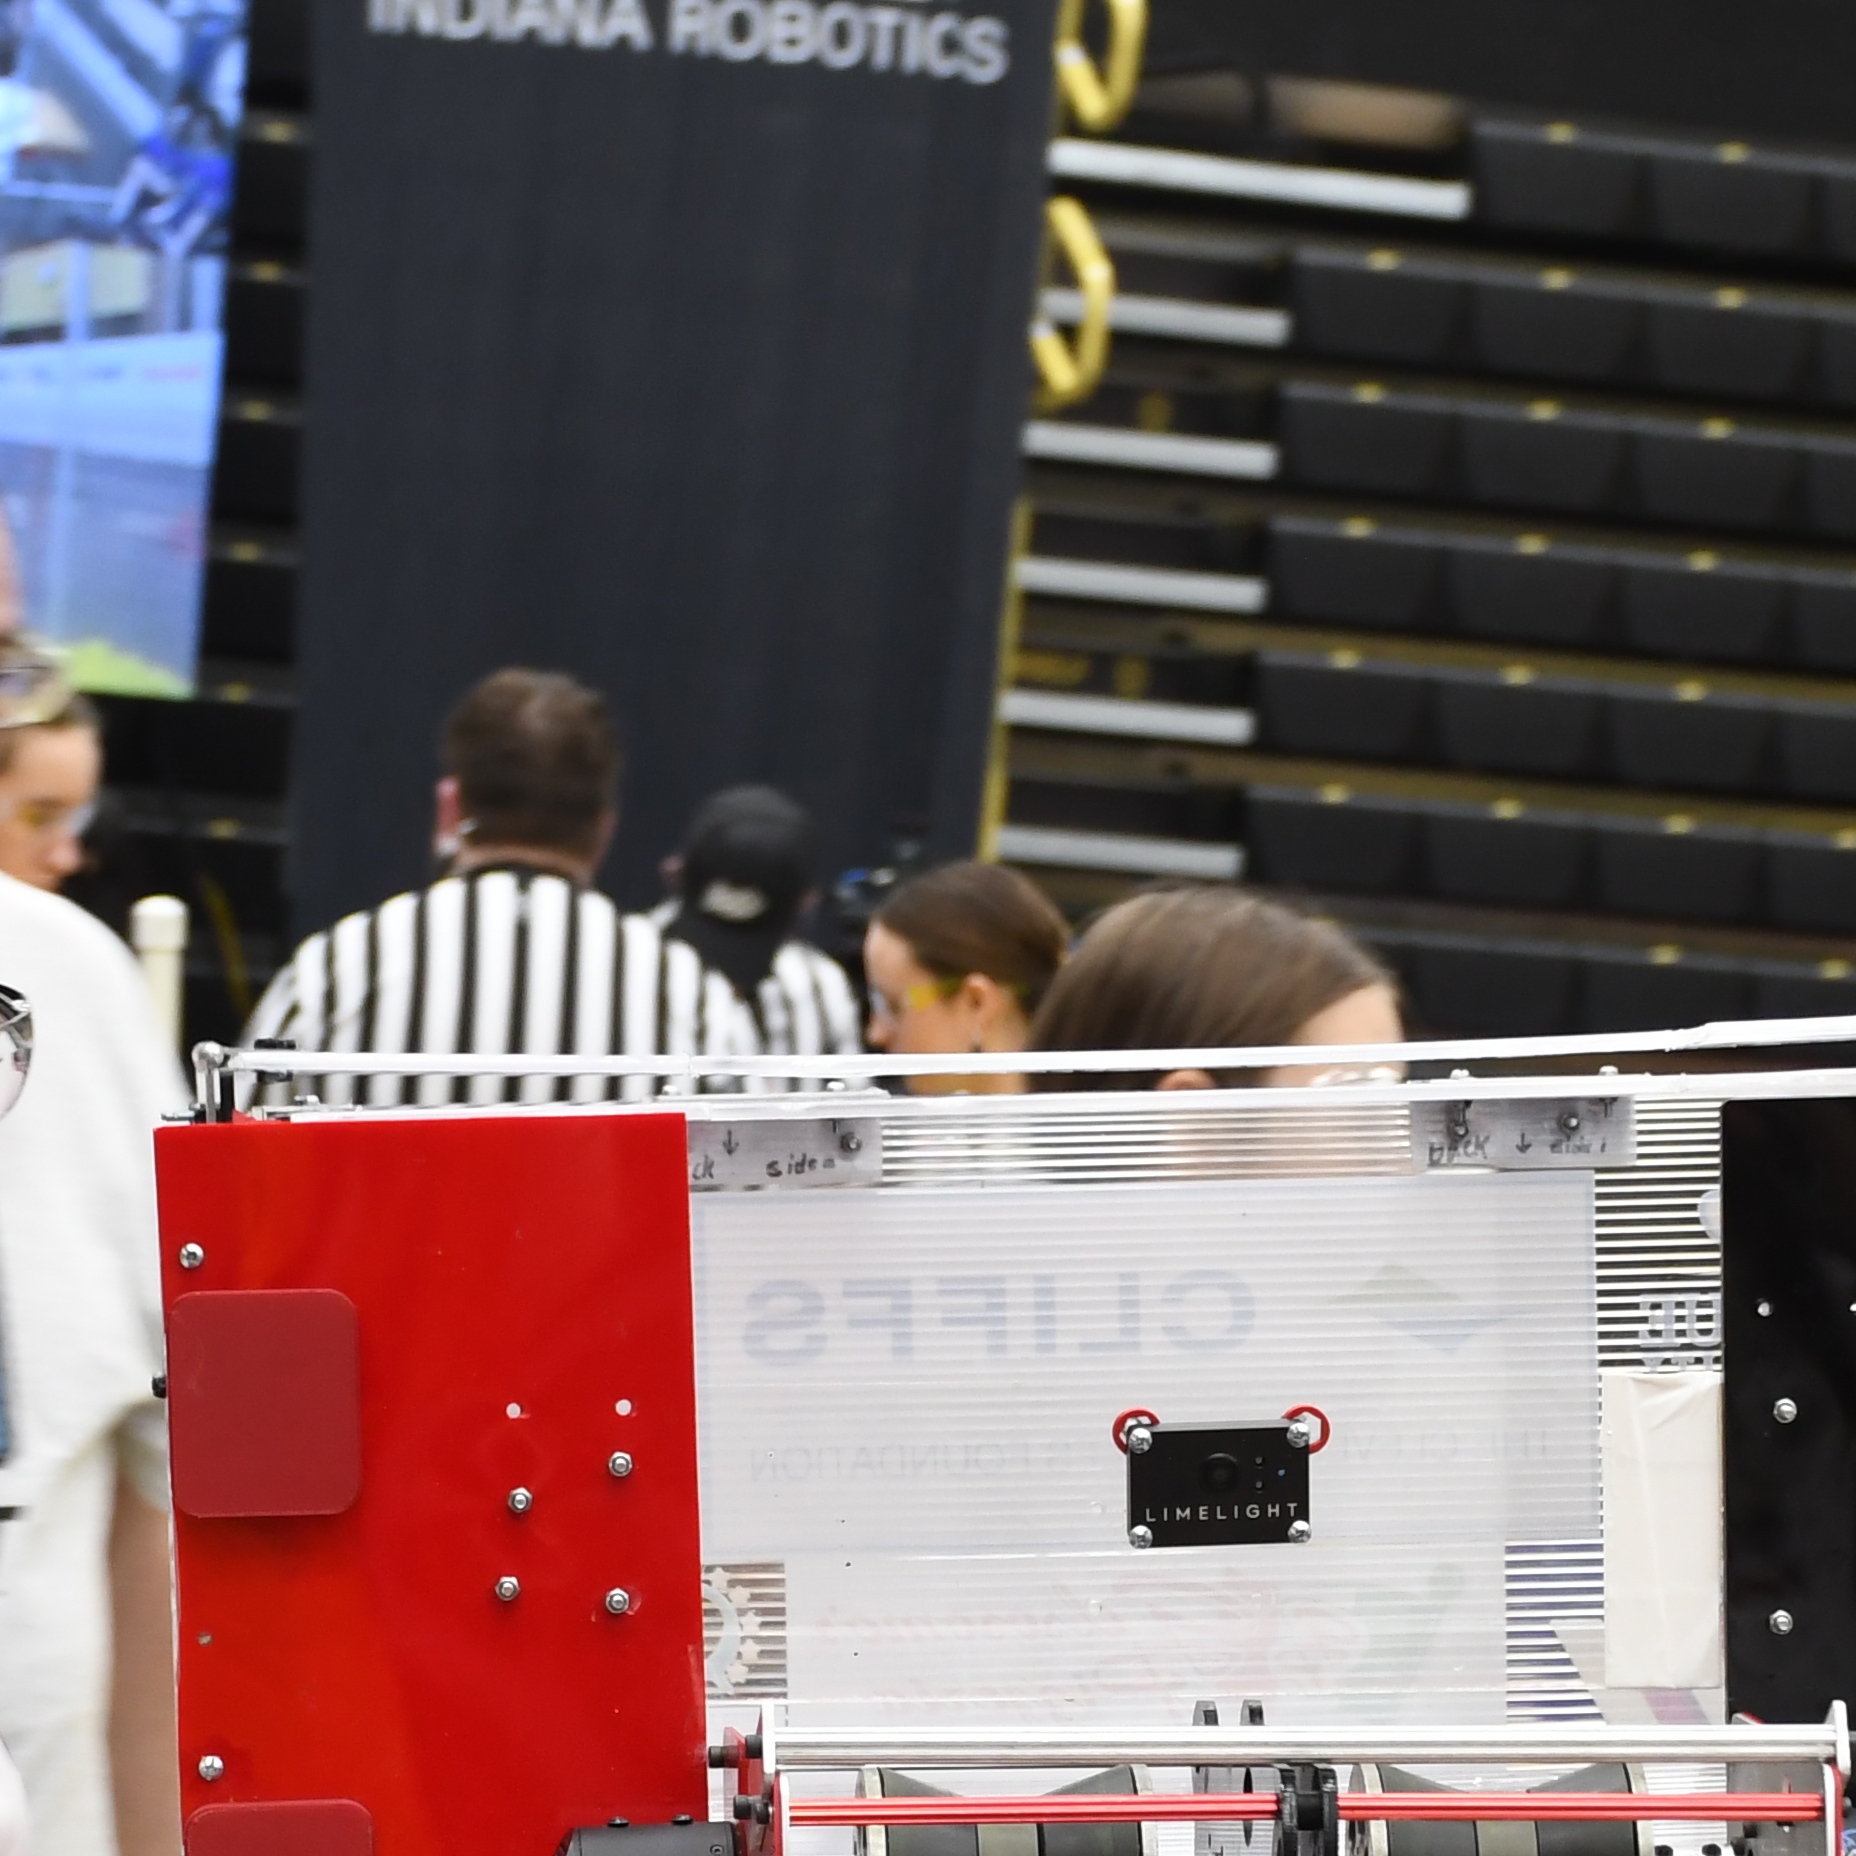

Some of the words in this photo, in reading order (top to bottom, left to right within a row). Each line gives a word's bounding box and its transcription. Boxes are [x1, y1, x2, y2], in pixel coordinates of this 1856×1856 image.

[367, 0, 654, 51] INDIANA
[666, 0, 1010, 85] ROBOTICS
[1145, 1502, 1299, 1523] LIMELIGHT
